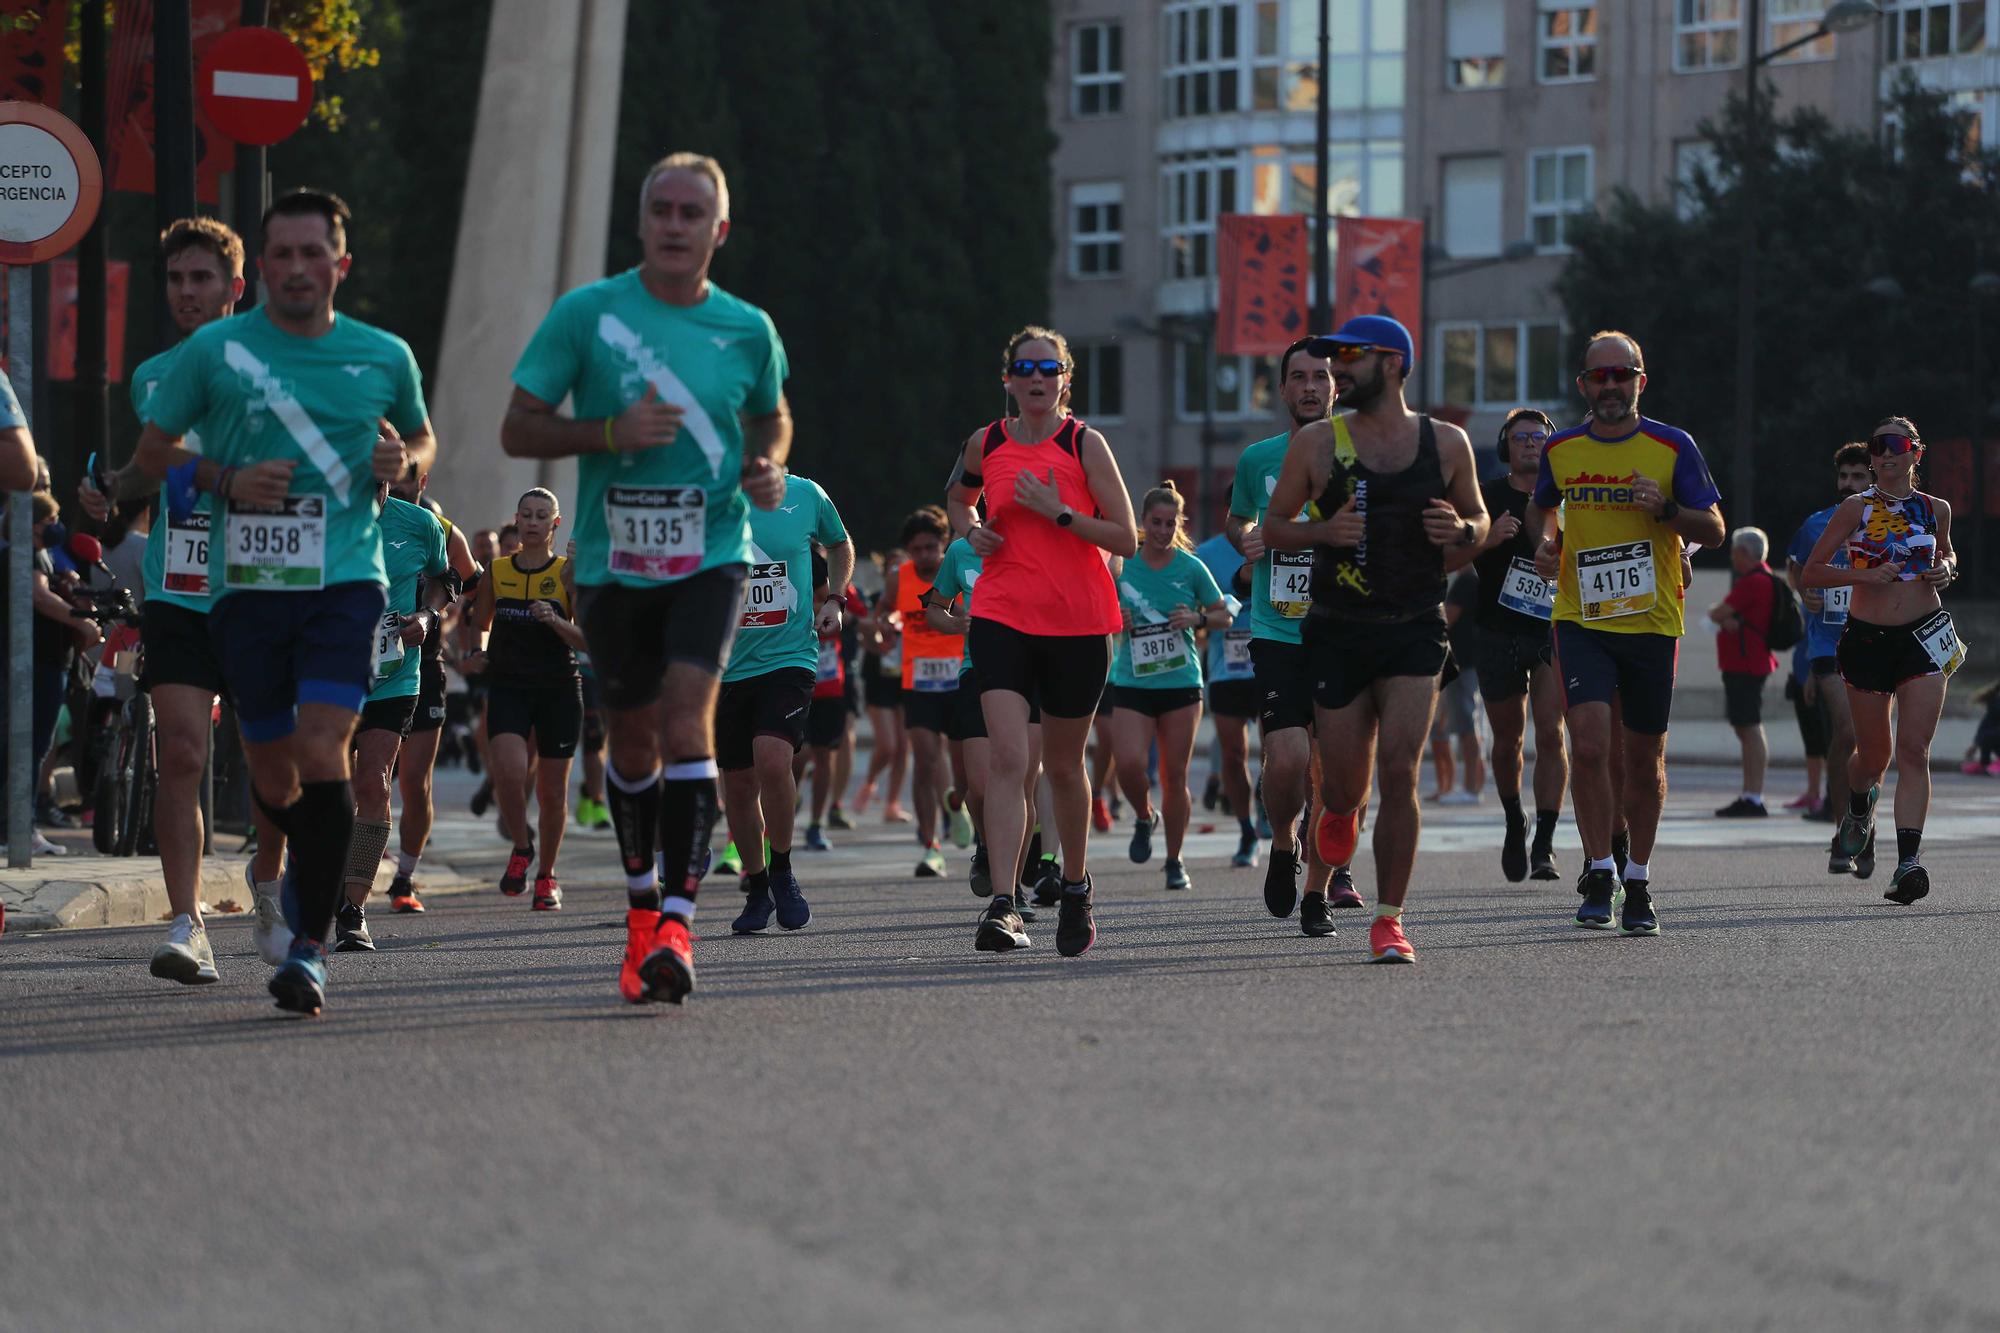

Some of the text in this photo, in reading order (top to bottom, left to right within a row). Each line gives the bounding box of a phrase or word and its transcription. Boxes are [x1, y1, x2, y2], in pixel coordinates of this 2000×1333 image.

[0, 165, 52, 178] CEPTO
[240, 524, 301, 555] 3958
[624, 517, 683, 546] 3135
[185, 538, 209, 565] 76
[1584, 550, 1623, 563] iberCaja
[1286, 573, 1309, 595] 42
[1593, 566, 1641, 593] 4176
[1611, 592, 1627, 600] CAPI
[1833, 590, 1849, 606] 51
[1588, 602, 1601, 615] 02
[1922, 615, 1949, 637] iberCaja
[1142, 638, 1175, 657] 3876
